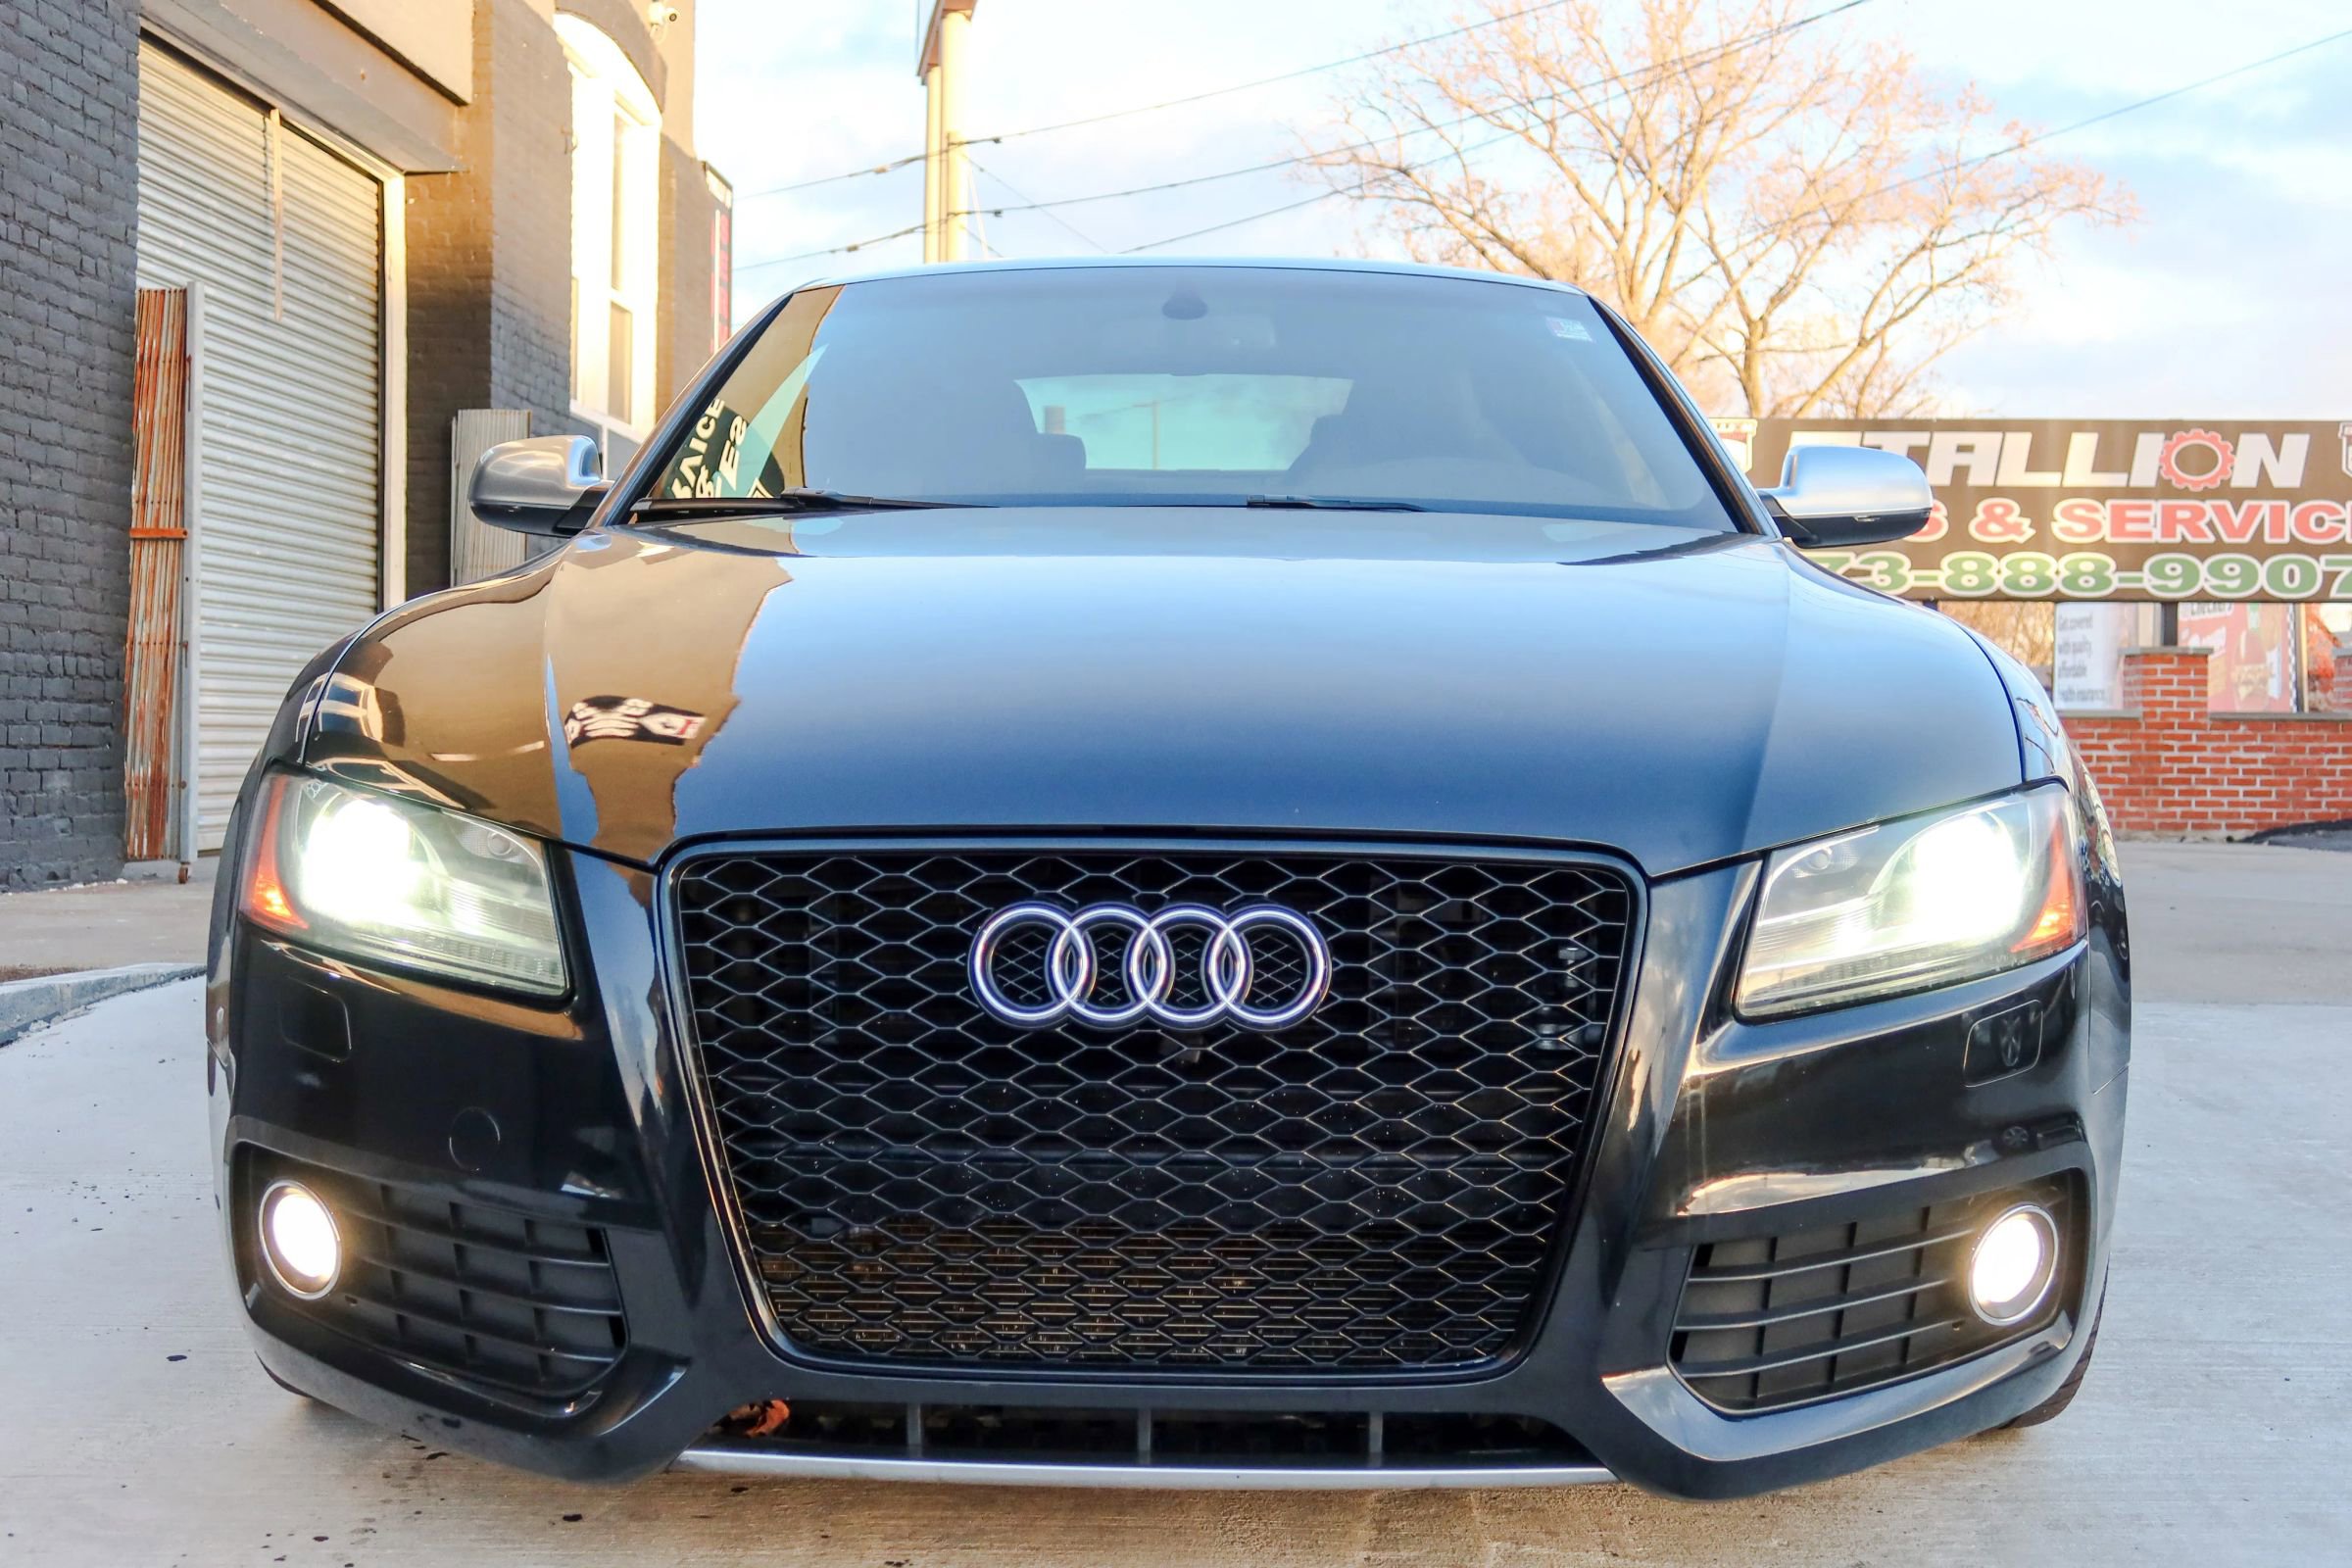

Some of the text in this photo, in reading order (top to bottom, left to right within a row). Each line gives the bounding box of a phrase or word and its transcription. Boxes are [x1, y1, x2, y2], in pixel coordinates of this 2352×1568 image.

[1788, 428, 2311, 492] TALLION
[1969, 498, 2035, 543] &
[2051, 498, 2352, 544] SERVIC
[1803, 551, 2352, 599] 73-888-9907
